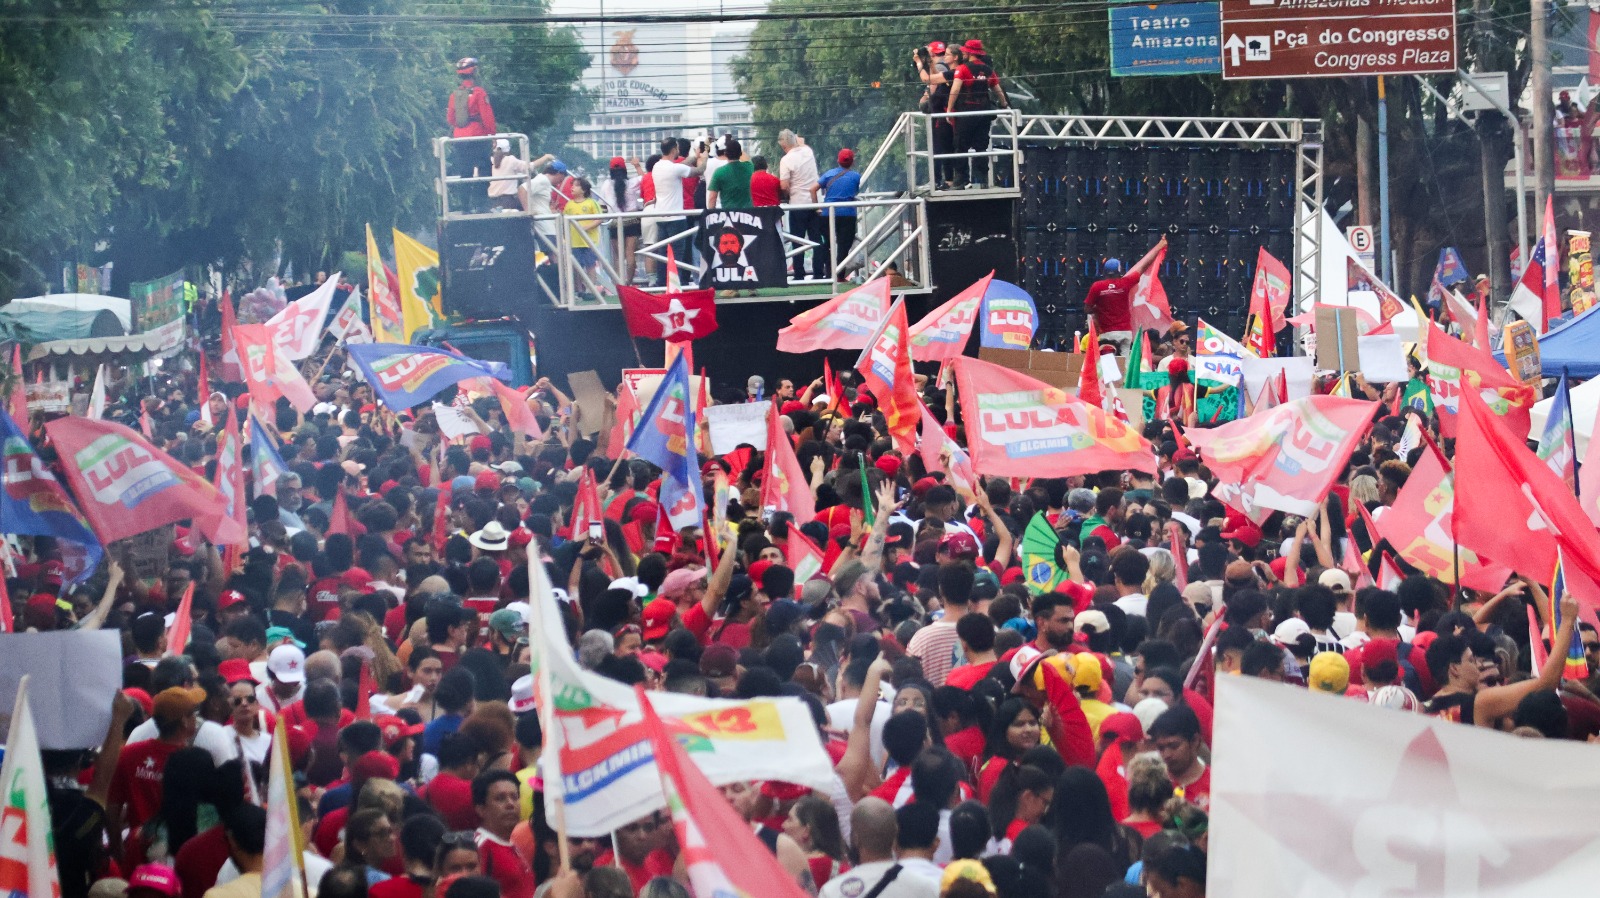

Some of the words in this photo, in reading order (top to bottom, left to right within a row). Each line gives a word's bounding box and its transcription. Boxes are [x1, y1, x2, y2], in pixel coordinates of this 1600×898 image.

[1130, 16, 1190, 31] Teatro
[1274, 30, 1308, 48] Pça
[1319, 29, 1343, 44] do
[1348, 28, 1450, 46] Congresso
[1314, 51, 1397, 70] Congress
[1402, 49, 1450, 64] Plaza
[617, 80, 627, 88] DE
[1357, 232, 1364, 246] E
[713, 266, 759, 282] ULA
[983, 408, 1081, 432] LULA
[1090, 409, 1127, 439] 13
[1019, 438, 1068, 453] ALCKMIN
[87, 447, 152, 492] LUL
